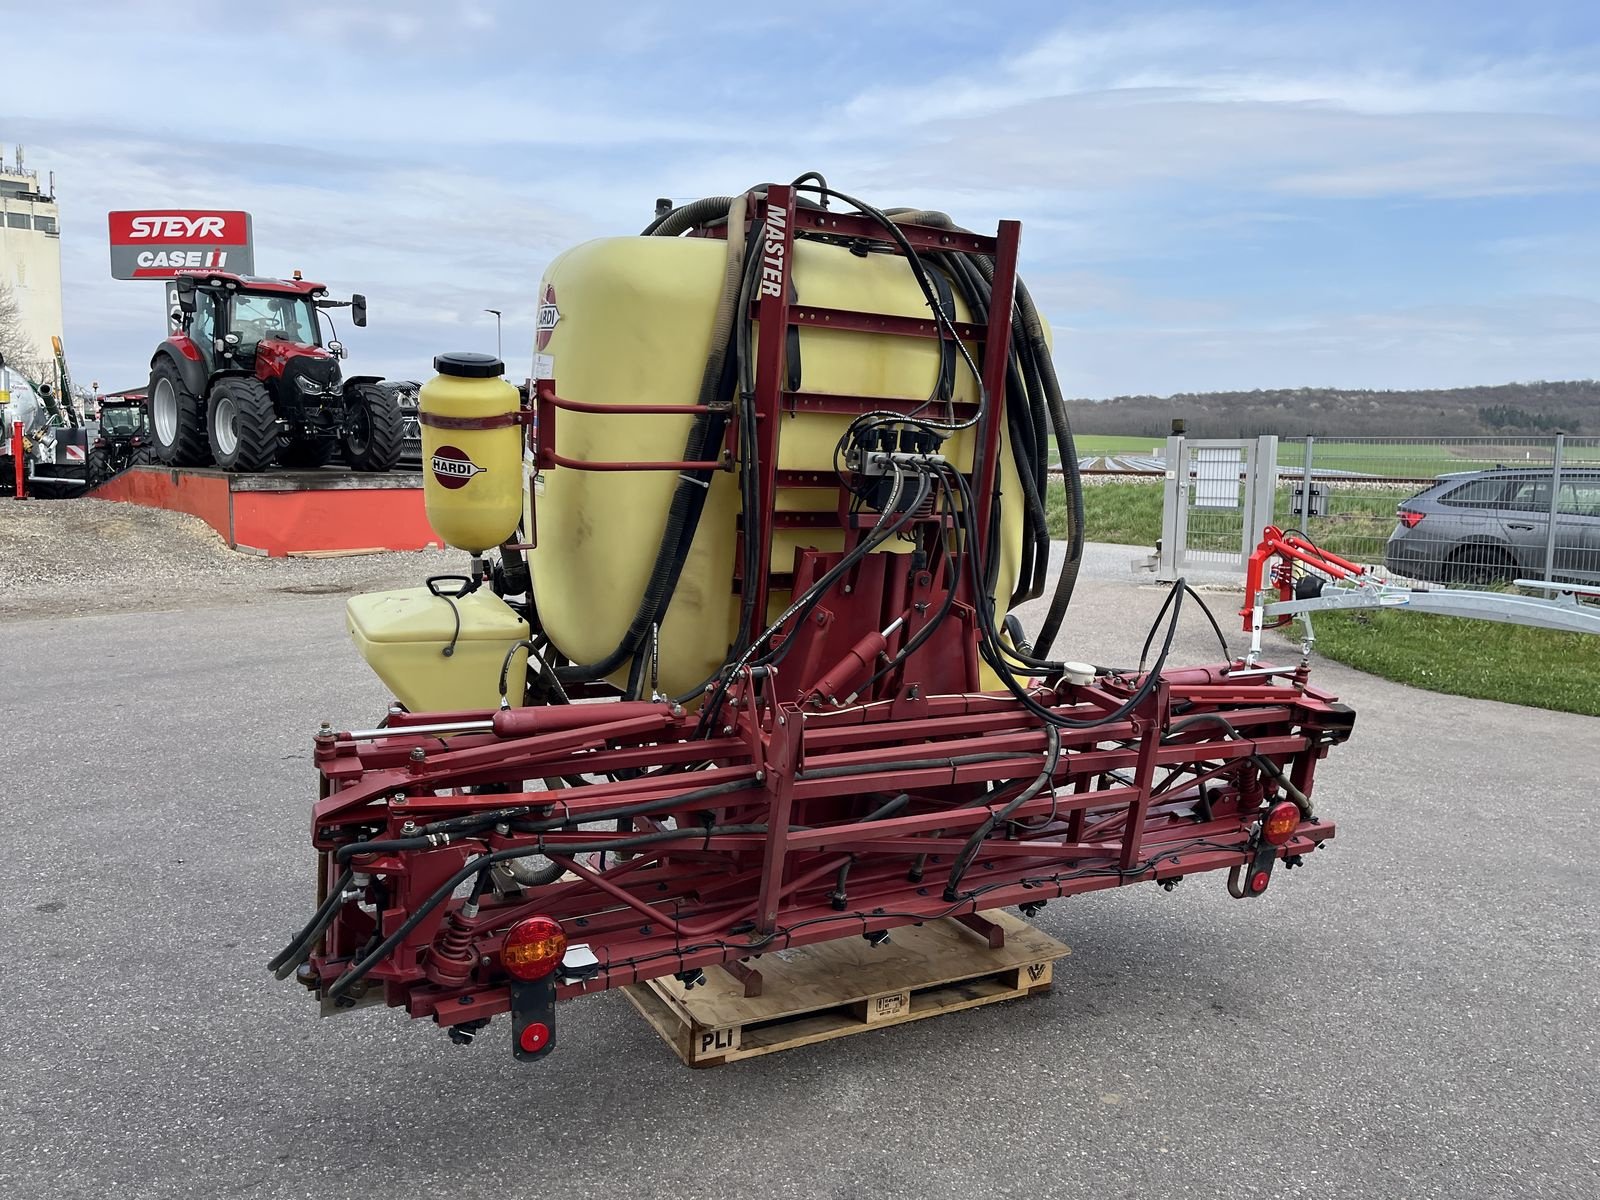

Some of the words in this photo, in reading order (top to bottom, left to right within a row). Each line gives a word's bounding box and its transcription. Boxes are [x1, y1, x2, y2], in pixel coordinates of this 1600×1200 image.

[129, 216, 225, 238] STEYR
[762, 204, 787, 297] MASTER
[137, 251, 202, 267] CASE
[539, 310, 555, 324] ARDI
[432, 459, 471, 475] HARDI
